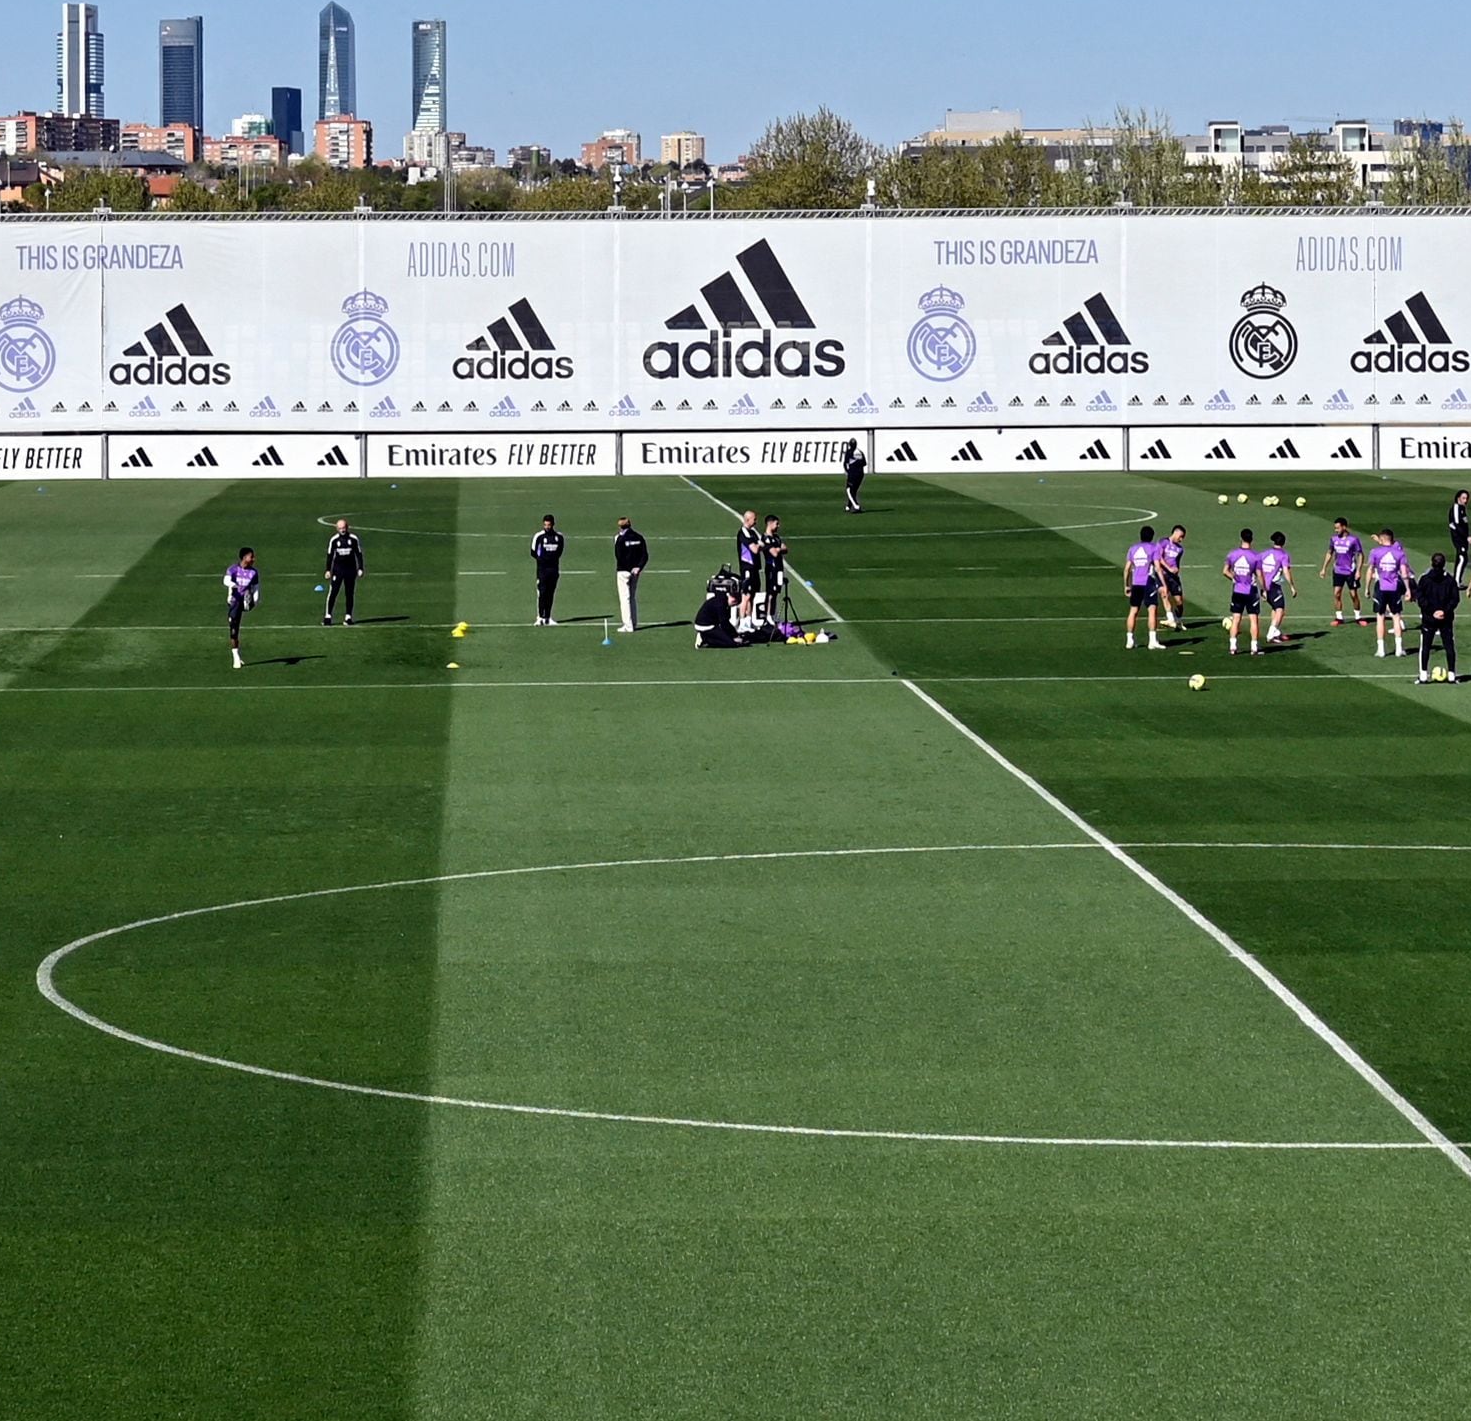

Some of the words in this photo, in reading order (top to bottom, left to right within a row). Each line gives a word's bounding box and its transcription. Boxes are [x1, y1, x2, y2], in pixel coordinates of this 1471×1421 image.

[16, 246, 57, 270] THIS
[63, 245, 78, 270] IS
[83, 244, 183, 270] GRANDEZA
[408, 242, 514, 277] ADIDAS.COM
[934, 241, 975, 265] THIS
[980, 240, 995, 264] IS
[1001, 240, 1098, 264] GRANDEZA
[1296, 236, 1401, 271] ADIDAS.COM
[643, 330, 845, 379] adidas
[1029, 345, 1149, 374] adidas
[1350, 343, 1470, 373] adidas
[109, 356, 231, 385] adidas
[453, 350, 573, 379] adidas
[609, 408, 640, 416] adidas
[728, 407, 760, 415] adidas
[848, 406, 879, 414] adidas
[967, 404, 998, 412] adidas
[1086, 403, 1117, 411] adidas
[1204, 402, 1235, 410] adidas
[1323, 402, 1354, 410] adidas
[1441, 401, 1471, 409] adidas
[9, 410, 40, 418] adidas
[129, 409, 160, 417] adidas
[249, 409, 281, 417] adidas
[489, 409, 521, 417] adidas
[25, 448, 82, 469] BETTER
[388, 444, 496, 466] Emirates
[508, 444, 538, 465] FLY
[539, 444, 596, 465] BETTER
[642, 442, 750, 463] Emirates
[762, 442, 791, 463] FLY
